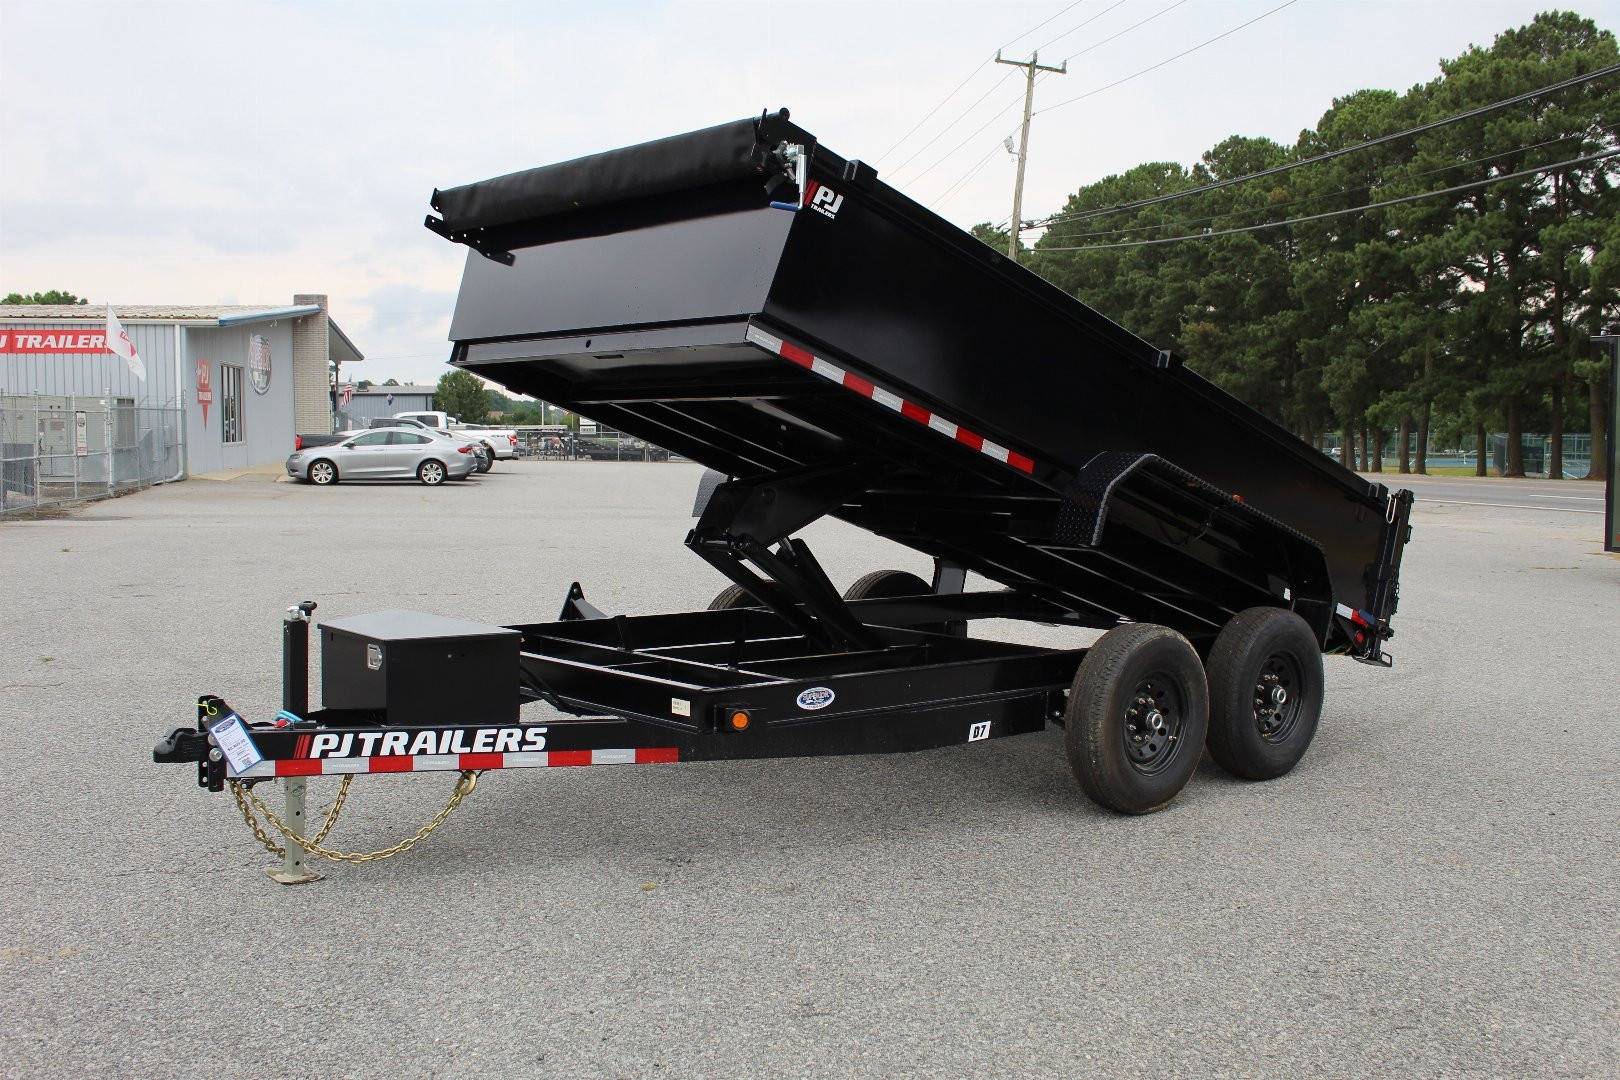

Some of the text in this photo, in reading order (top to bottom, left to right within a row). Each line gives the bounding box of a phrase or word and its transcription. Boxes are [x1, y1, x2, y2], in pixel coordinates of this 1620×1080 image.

[813, 185, 844, 214] PJ
[811, 203, 836, 220] TRAILERS
[201, 364, 209, 384] PJ
[973, 724, 987, 739] D7
[309, 727, 548, 759] PJ TRAILERS
